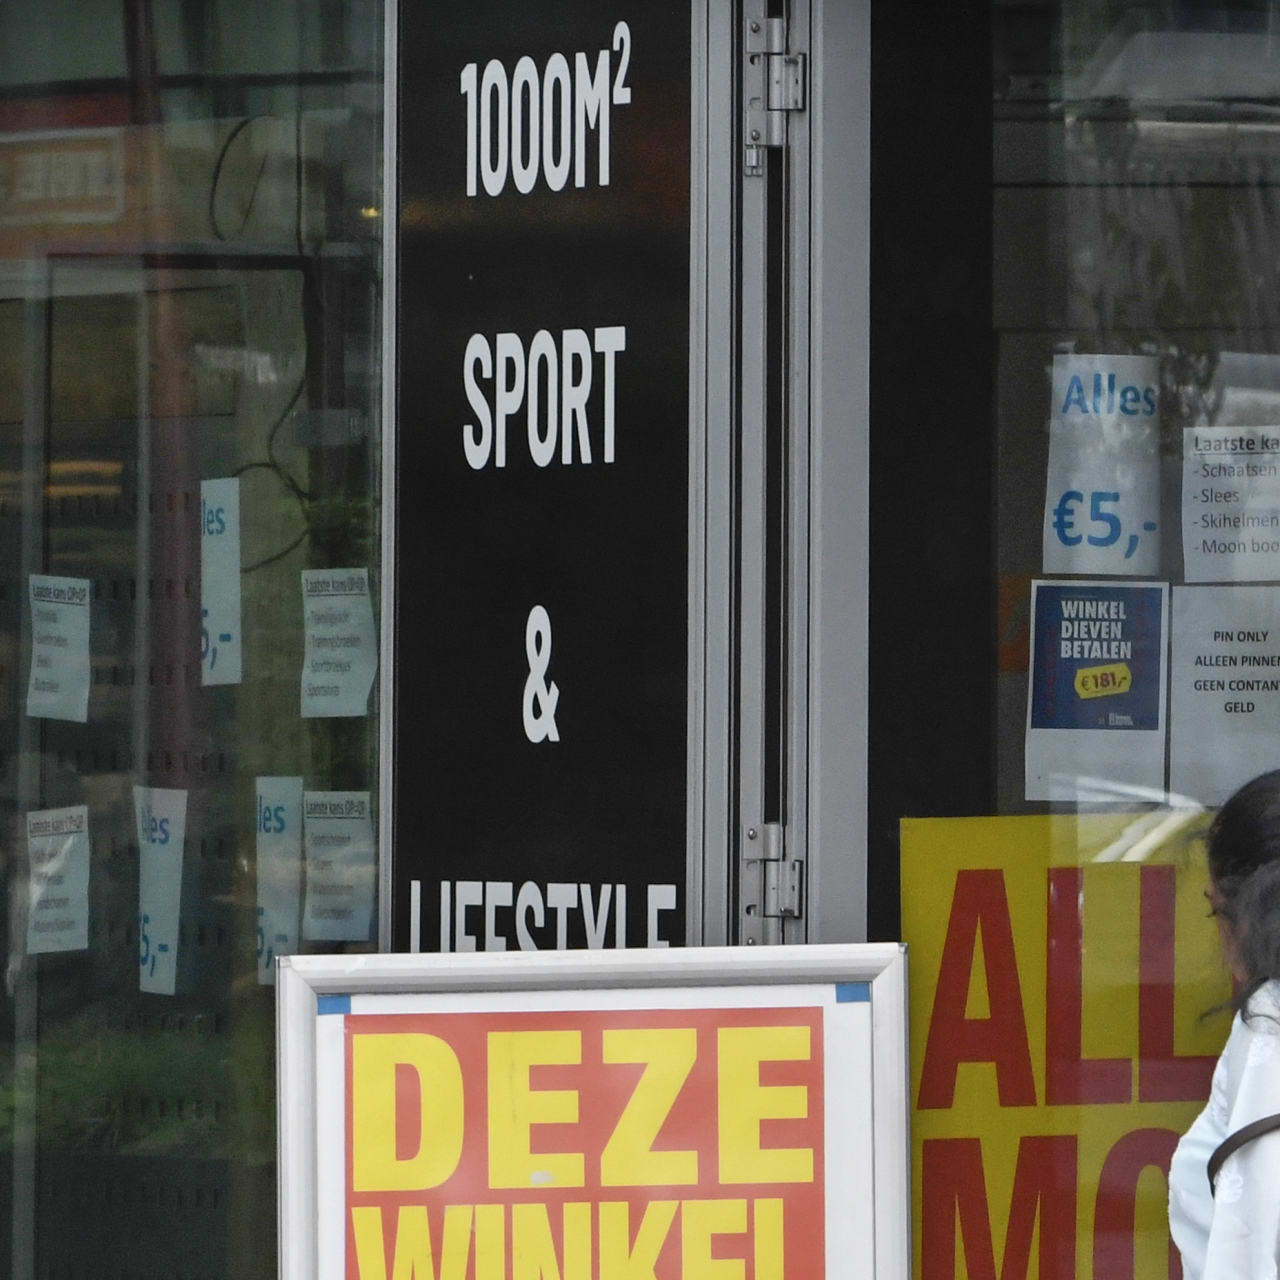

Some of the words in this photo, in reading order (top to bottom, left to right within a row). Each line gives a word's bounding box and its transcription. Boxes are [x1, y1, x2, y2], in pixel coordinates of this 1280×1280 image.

[463, 326, 626, 469] SPORT
[1062, 373, 1157, 417] Alles
[1194, 435, 1255, 451] Laatste
[1202, 463, 1277, 478] Schaatsen
[1201, 488, 1240, 503] Slees
[1053, 490, 1158, 560] €5,-
[1201, 512, 1279, 529] Skihelmen
[1202, 539, 1246, 554] Moon
[1060, 600, 1127, 619] WINKEL
[1060, 620, 1122, 639] DIEVEN
[1213, 631, 1233, 642] PIN
[1237, 631, 1269, 642] ONLY
[1060, 641, 1132, 659] BETALEN
[1195, 656, 1237, 667] ALLEEN
[522, 605, 560, 743] &
[1194, 680, 1225, 691] GEEN
[1224, 702, 1255, 713] GELD
[916, 863, 1240, 1110] ALL
[350, 1025, 814, 1192] DEZE
